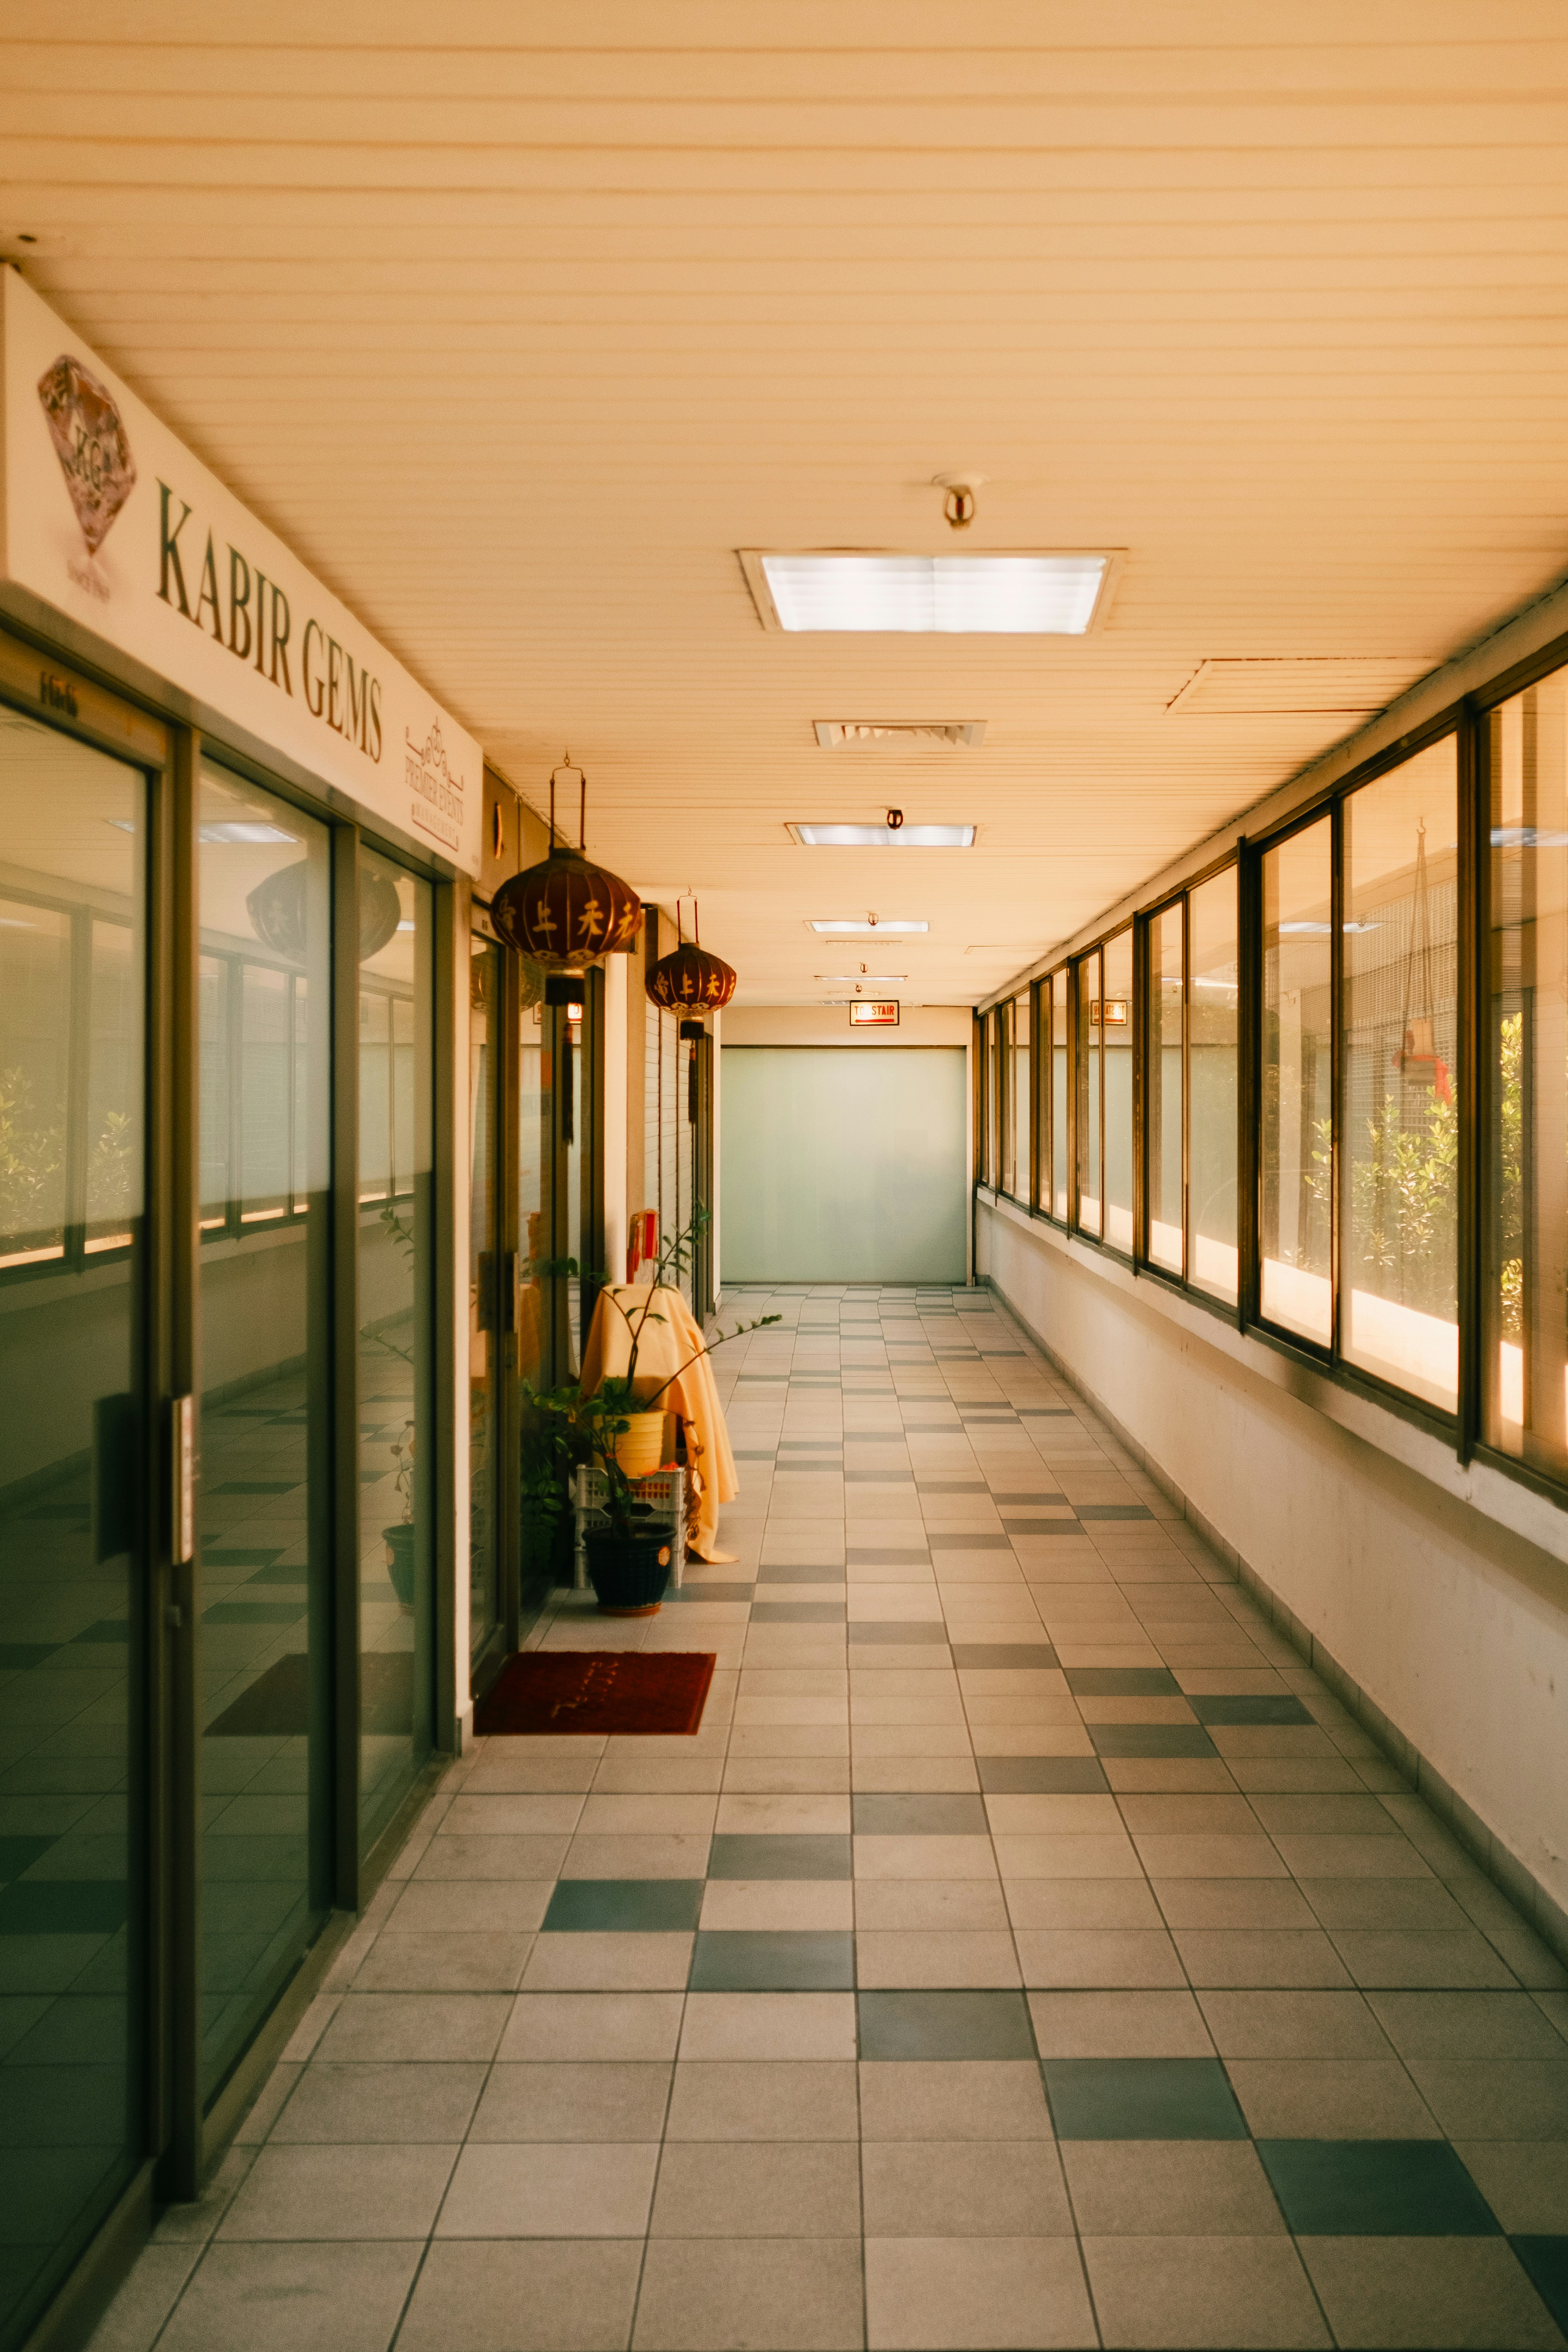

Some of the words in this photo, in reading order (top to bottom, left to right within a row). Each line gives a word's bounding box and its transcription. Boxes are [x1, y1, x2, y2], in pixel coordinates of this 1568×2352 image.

[156, 476, 294, 698] KABIR
[302, 618, 382, 765] GEMS
[405, 755, 438, 808] PREMIER
[439, 783, 464, 826] EVENTS
[855, 1006, 864, 1015] TO
[872, 1006, 894, 1015] STAIR
